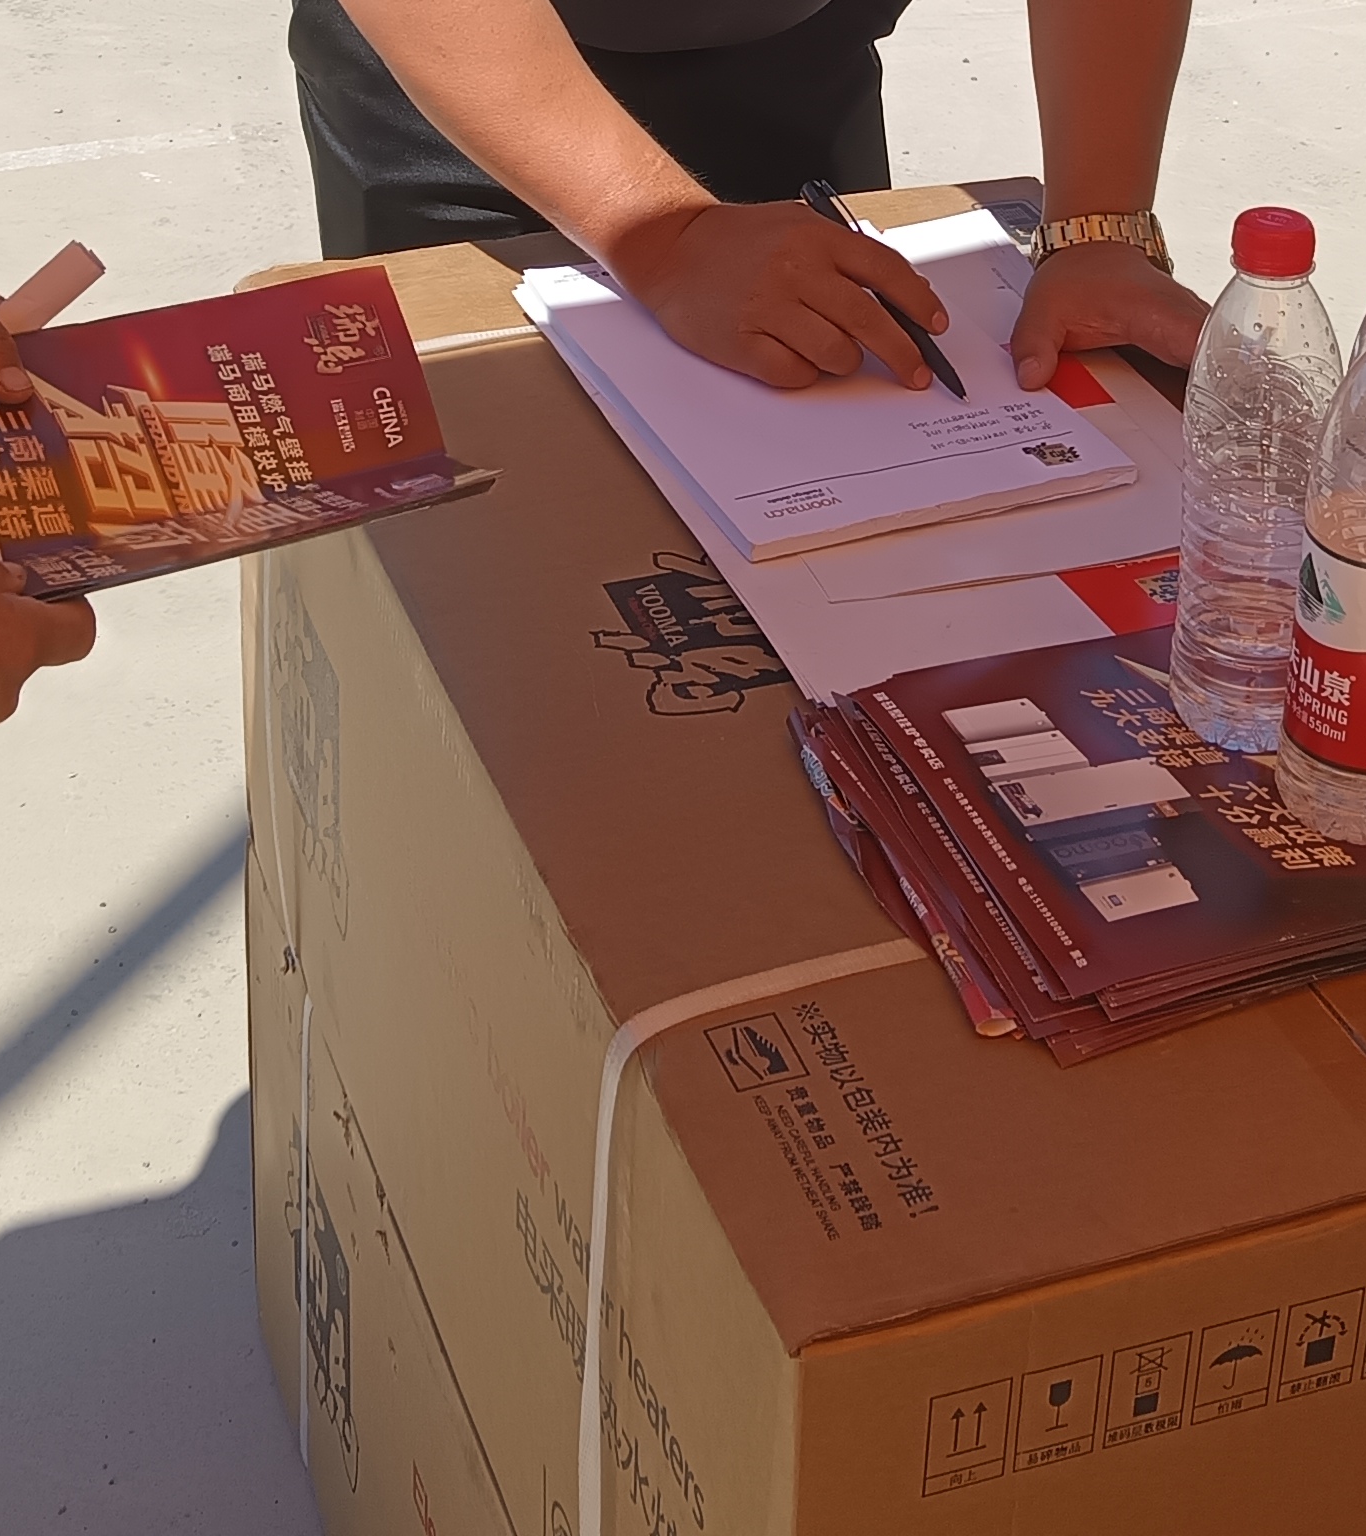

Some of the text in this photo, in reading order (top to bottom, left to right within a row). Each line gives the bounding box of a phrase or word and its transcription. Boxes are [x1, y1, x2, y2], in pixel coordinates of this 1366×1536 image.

[206, 343, 287, 495] 瑞马商用模块炉
[371, 386, 405, 449] CHINA
[763, 496, 843, 519] vooma.cn
[635, 583, 688, 647] VOOMA
[1079, 687, 1195, 769] 九大支持
[1114, 687, 1231, 766] 三商渠道
[1297, 689, 1349, 726] SPRING
[1198, 780, 1321, 871] 十分赢利
[1228, 780, 1357, 869] 六大政策
[753, 1094, 772, 1118] KEEP
[765, 1116, 786, 1141] AWAY
[815, 1209, 841, 1242] SHAKE
[776, 1104, 842, 1213] NEED CAREFUL HANDLING
[786, 1085, 883, 1232] 贵重物品 严禁践踏
[620, 1304, 705, 1532] heaters
[1215, 1398, 1244, 1417] 怕雨
[948, 1469, 979, 1488] 向上
